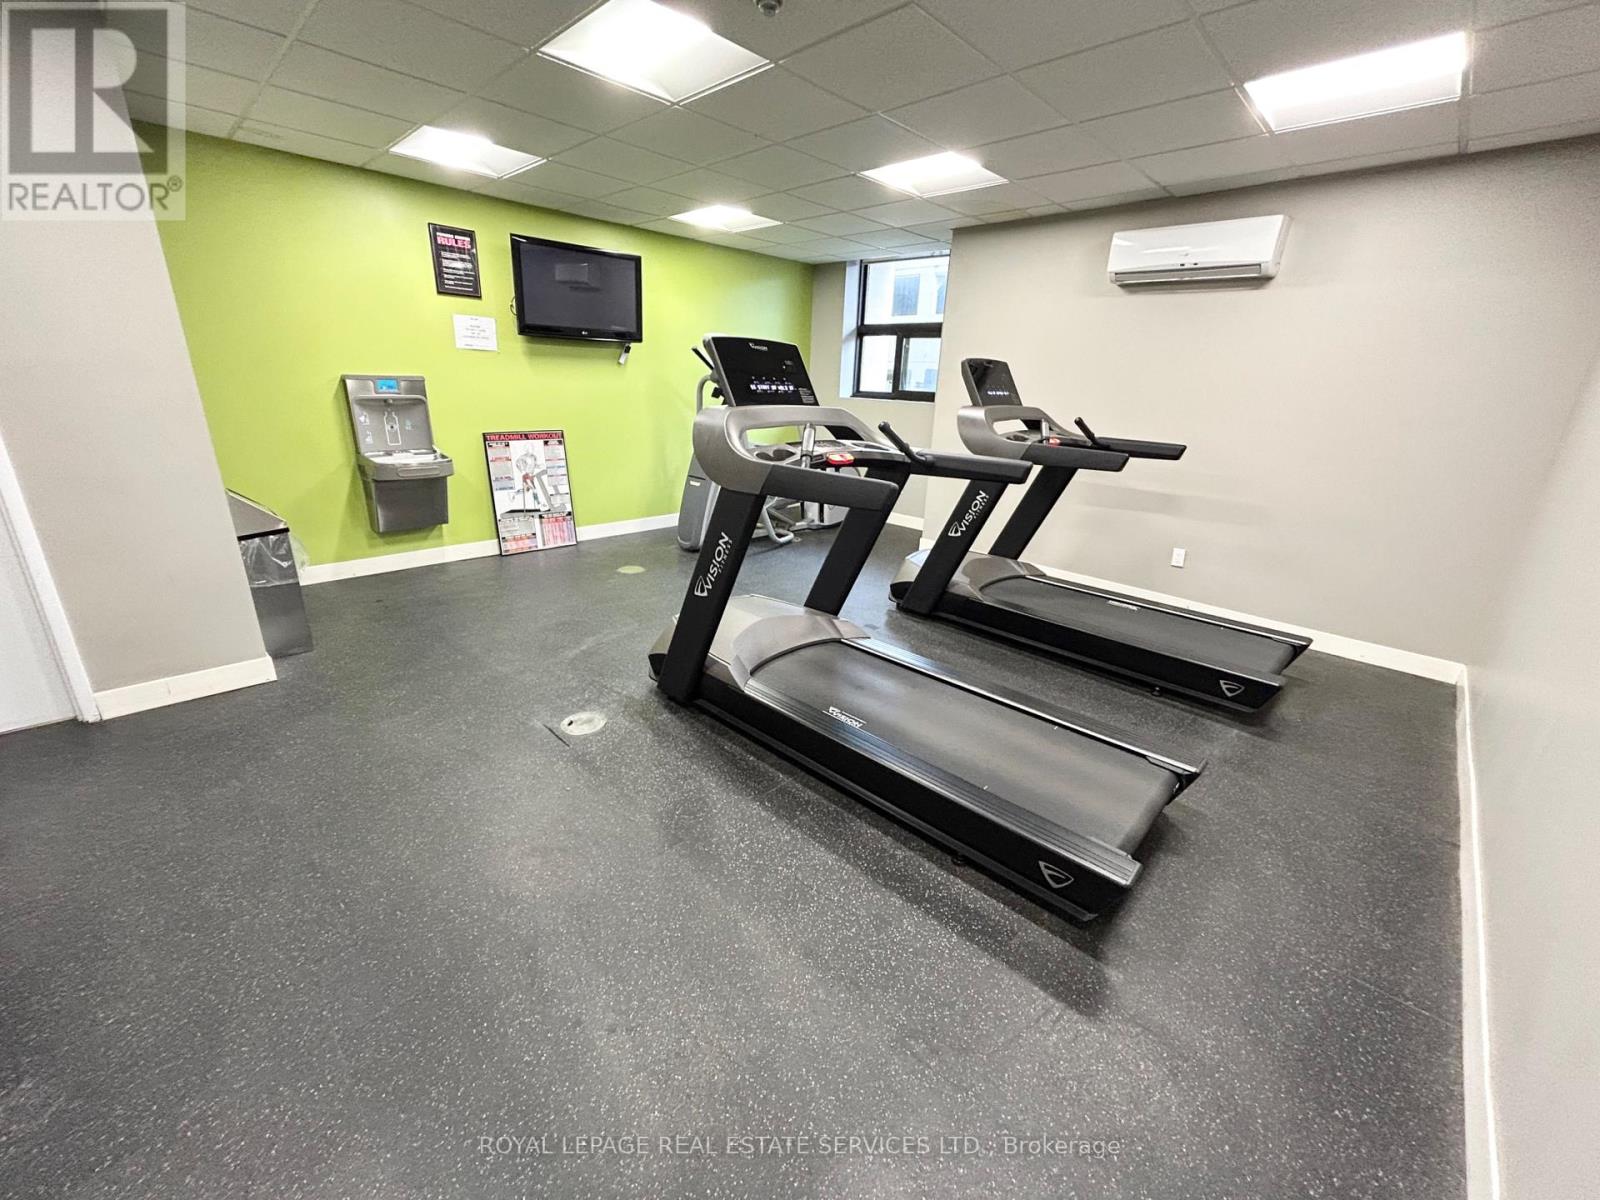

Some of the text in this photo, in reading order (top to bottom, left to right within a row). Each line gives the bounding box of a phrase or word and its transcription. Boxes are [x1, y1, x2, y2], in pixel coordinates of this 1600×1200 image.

[437, 236, 471, 249] RULES
[528, 432, 561, 440] WORKOUT
[959, 490, 986, 531] VISION
[705, 532, 729, 589] VISION
